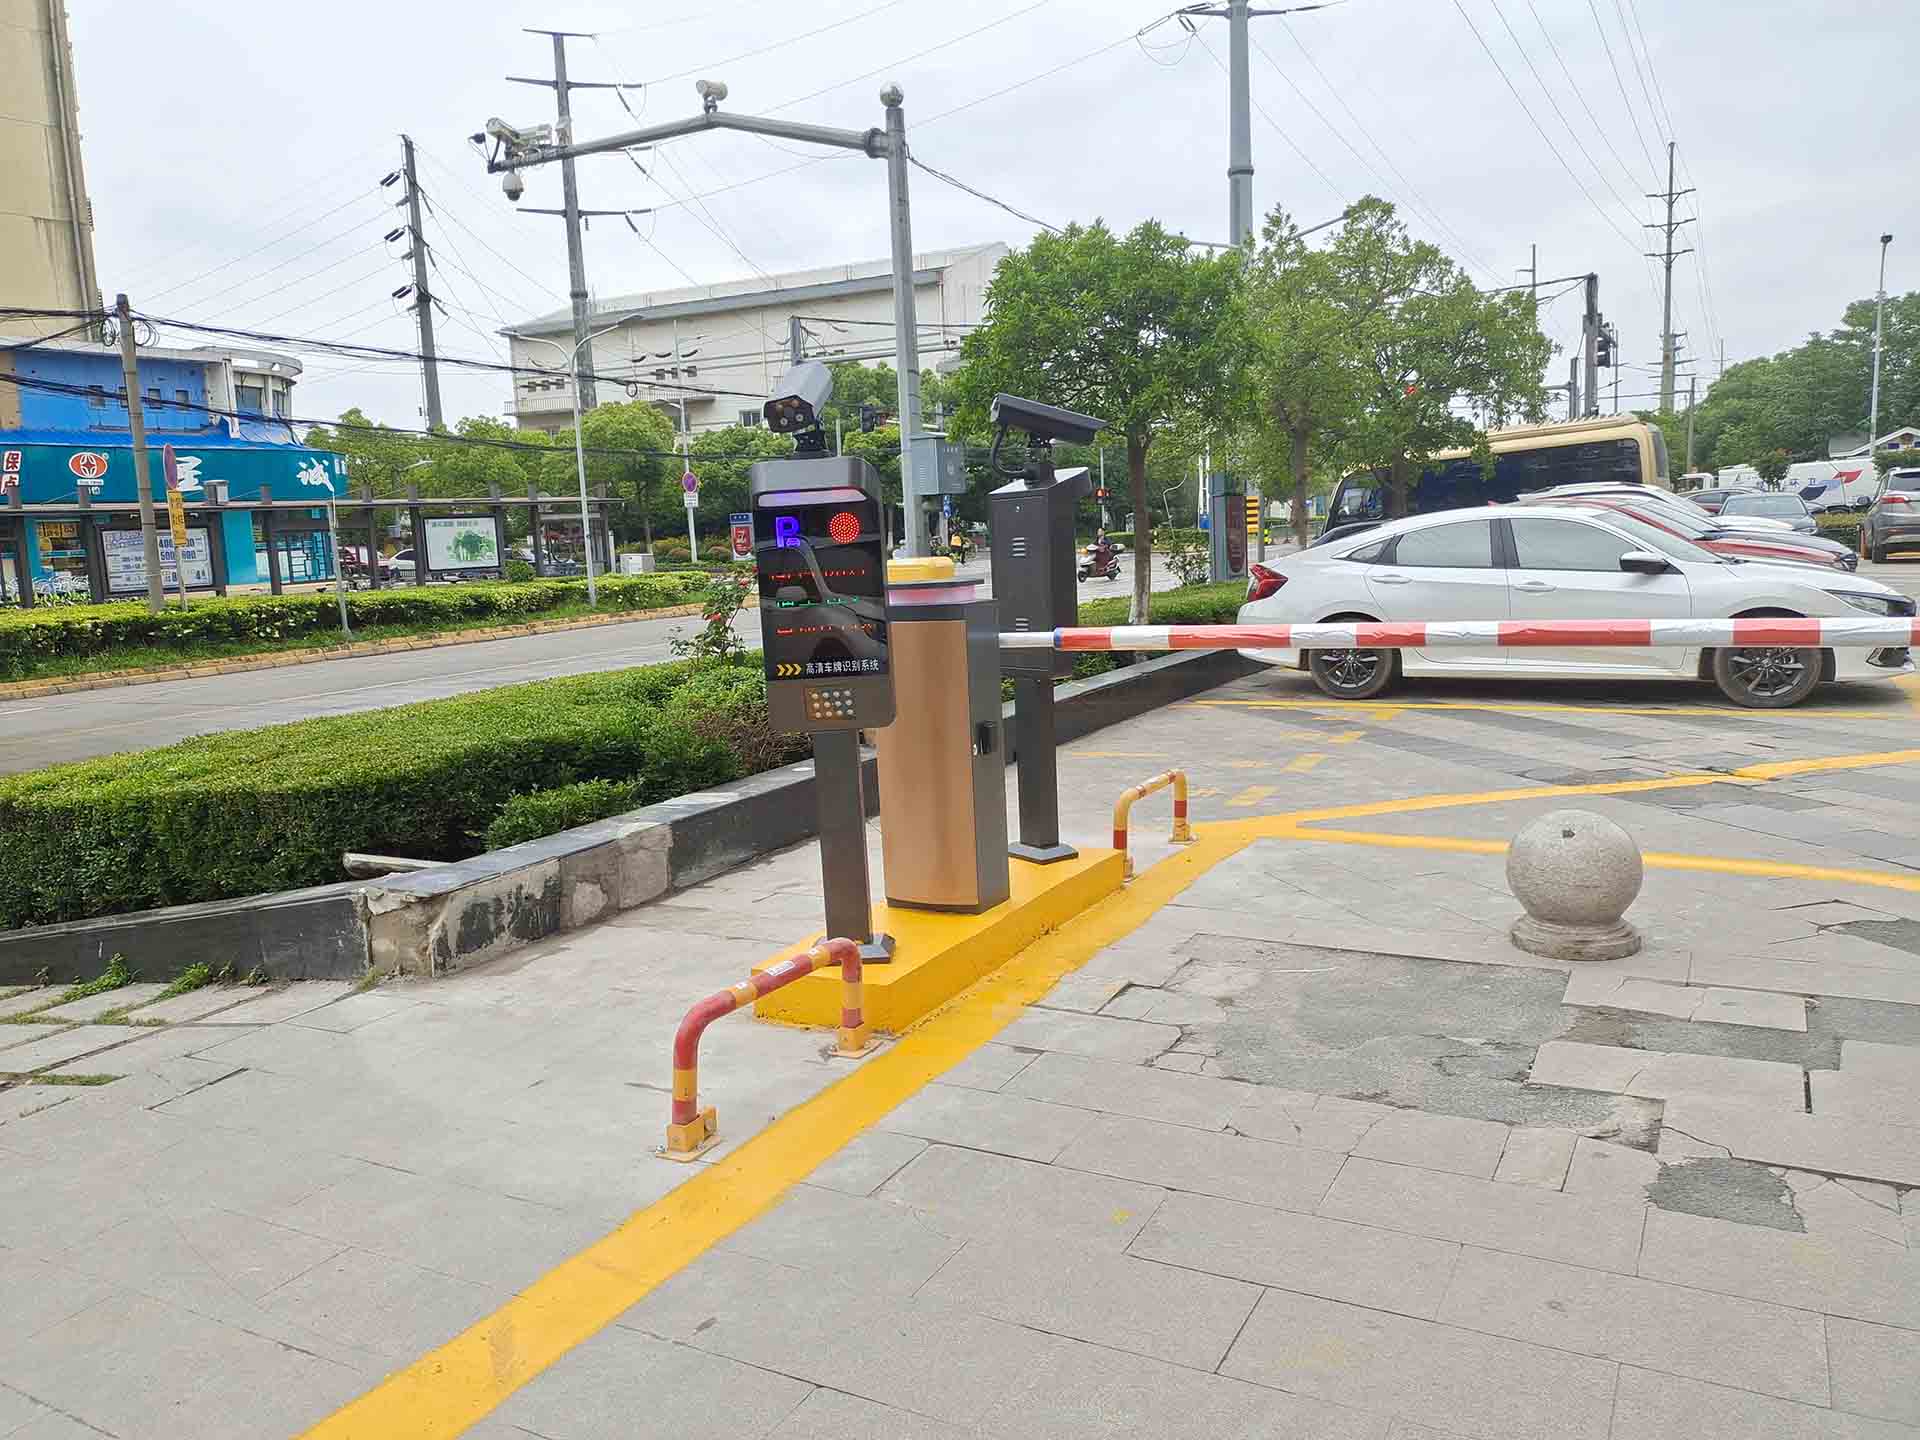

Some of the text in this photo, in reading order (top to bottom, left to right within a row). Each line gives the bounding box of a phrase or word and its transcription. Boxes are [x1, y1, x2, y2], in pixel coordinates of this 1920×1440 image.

[775, 516, 799, 548] P
[806, 659, 879, 674] 高清车牌识别系统
